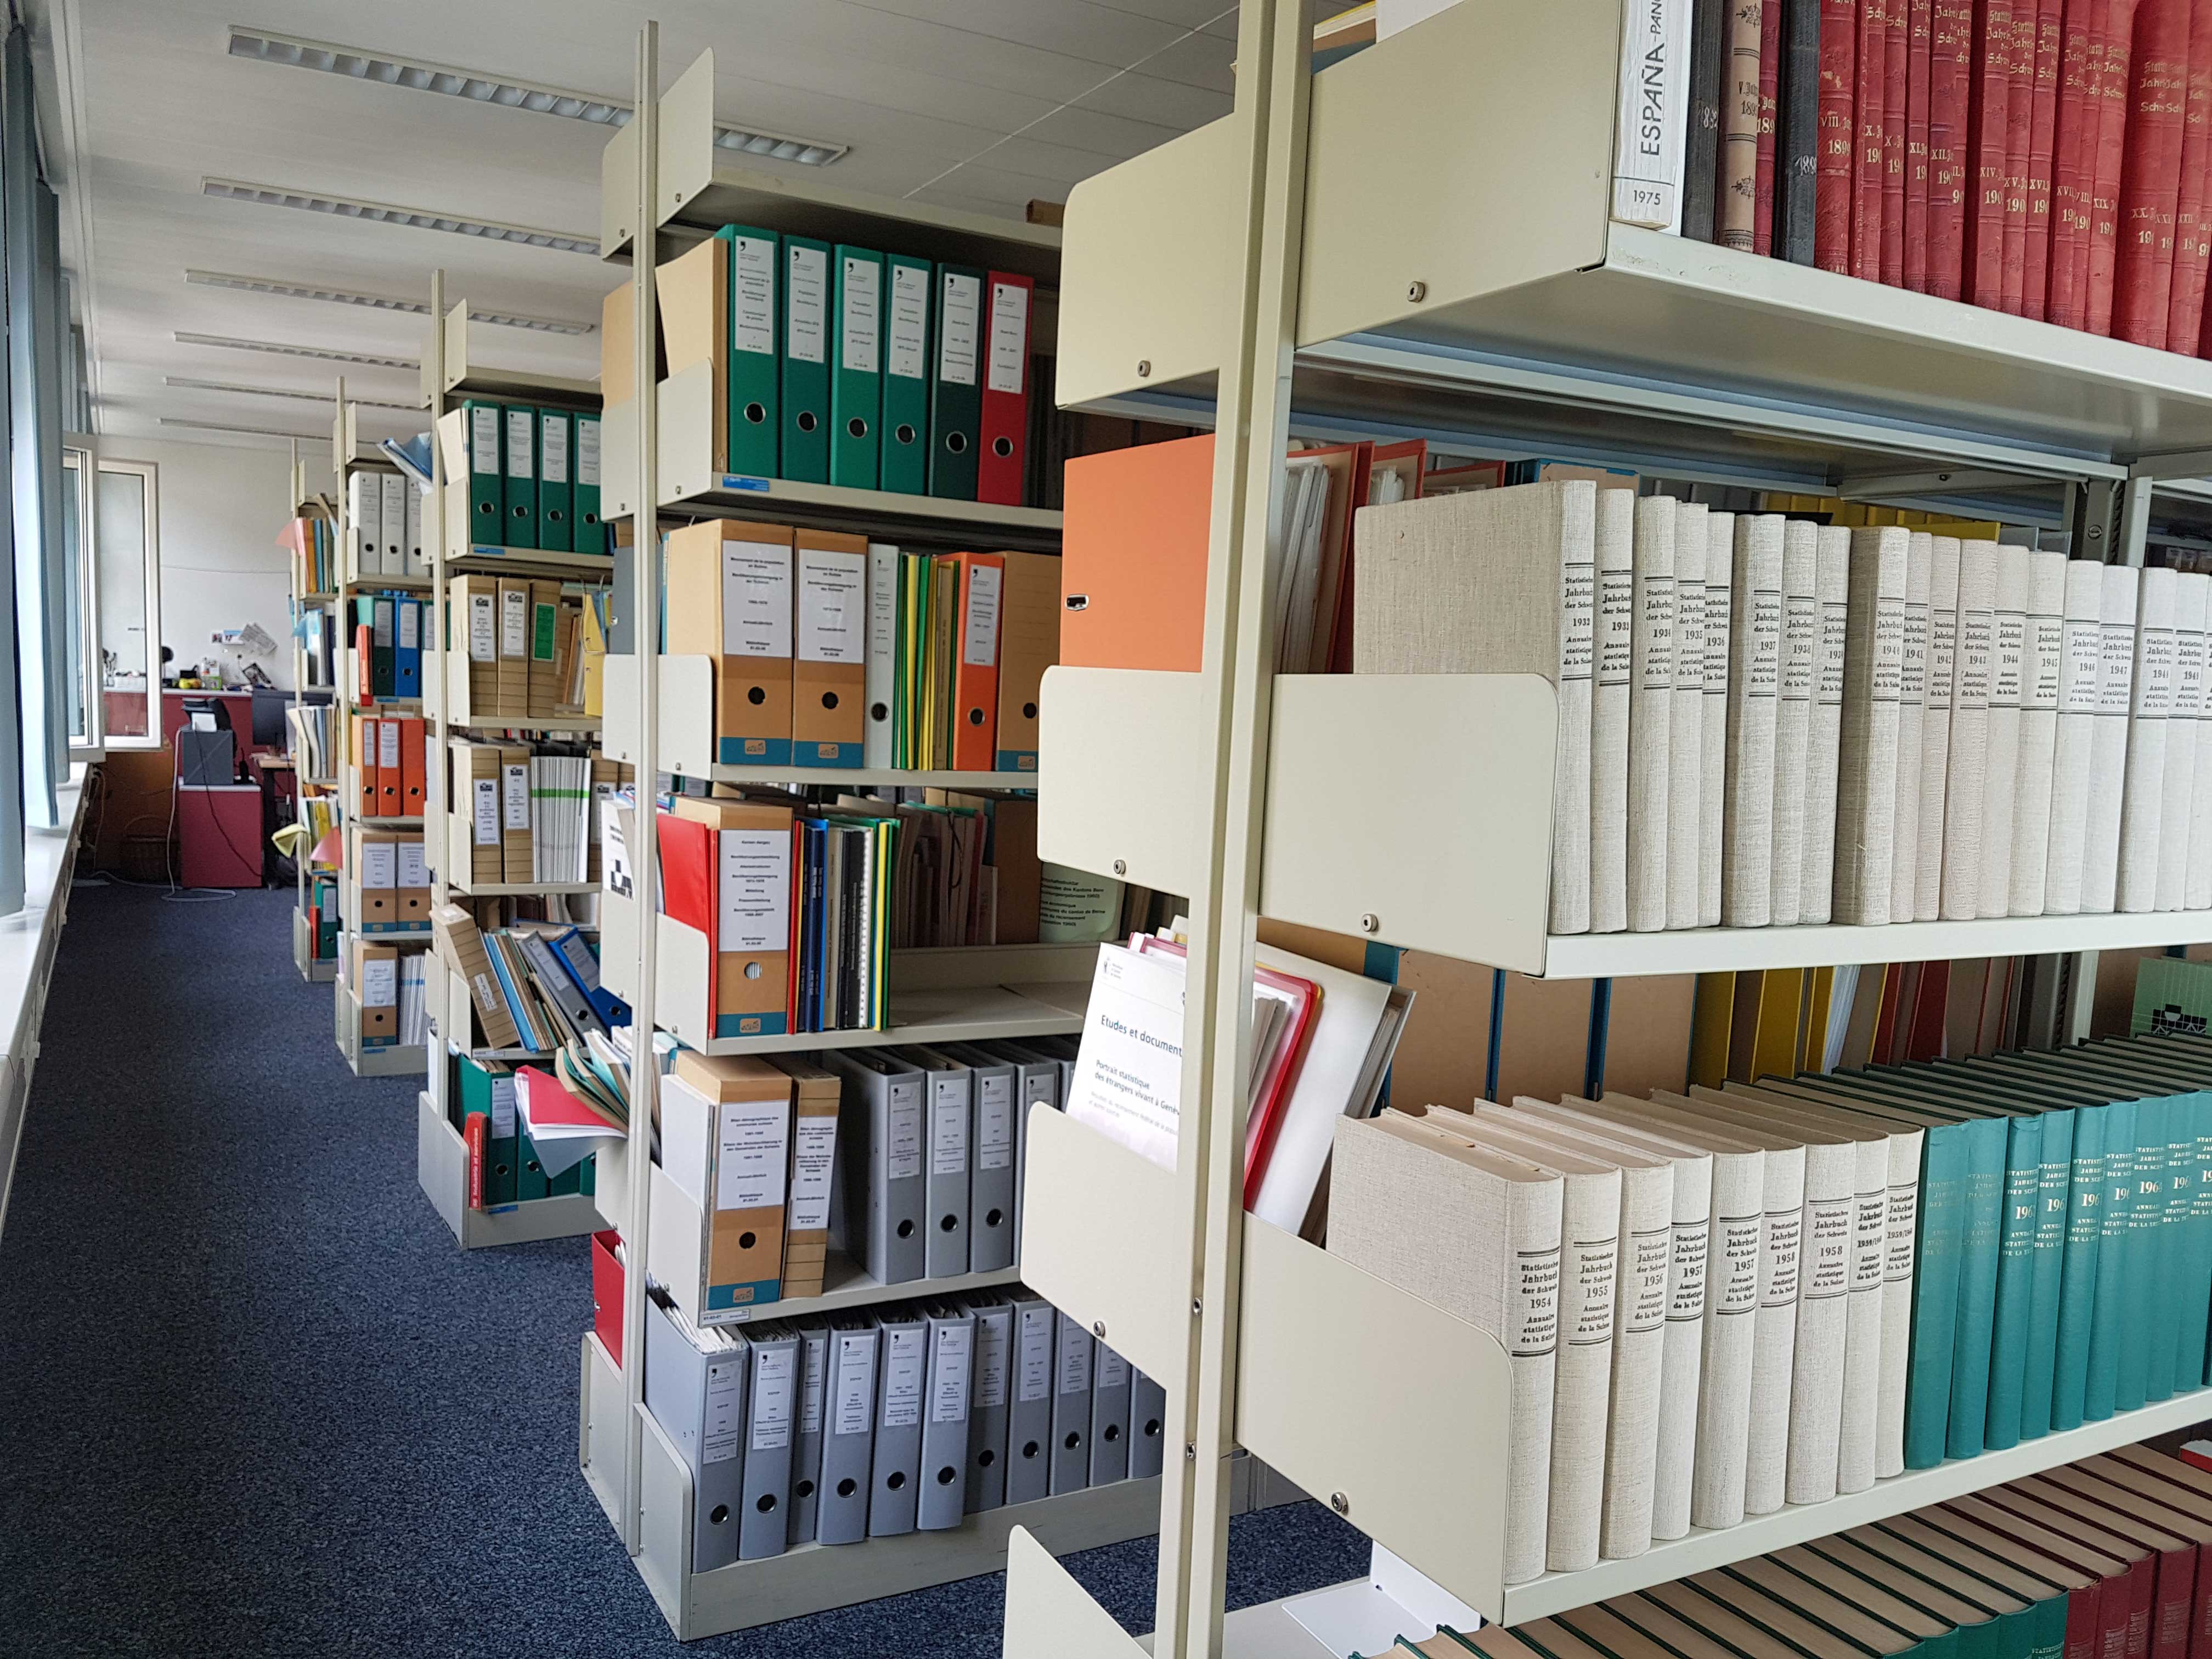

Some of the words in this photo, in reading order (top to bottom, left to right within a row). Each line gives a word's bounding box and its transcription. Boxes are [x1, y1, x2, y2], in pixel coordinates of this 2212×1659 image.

[1640, 43, 1665, 156] ESPAÑA
[1633, 190, 1661, 205] 1975
[1685, 630, 1702, 640] 1935
[1707, 636, 1724, 646] 1936
[1760, 641, 1776, 650] 1937
[2003, 654, 2018, 663] 1944
[2111, 665, 2128, 675] 1947
[1101, 1014, 1127, 1034] Etudes
[1130, 1029, 1137, 1039] et
[1096, 1059, 1118, 1075] Portrait
[1119, 1070, 1150, 1090] statistique
[1095, 1072, 1104, 1081] des
[1106, 1076, 1133, 1094] étrangers
[1135, 1090, 1154, 1103] vivant
[1814, 1220, 1847, 1229] Jahrbuch
[1820, 1245, 1843, 1257] 1958
[1776, 1251, 1795, 1265] 1958
[1580, 1261, 1612, 1274] Jahrbuch
[1683, 1265, 1702, 1278] 1957
[1735, 1258, 1754, 1272] 1957
[1644, 1273, 1663, 1286] 1956
[1586, 1285, 1608, 1299] 1955
[1530, 1297, 1551, 1308] 1954
[1583, 1303, 1609, 1312] Annuaire
